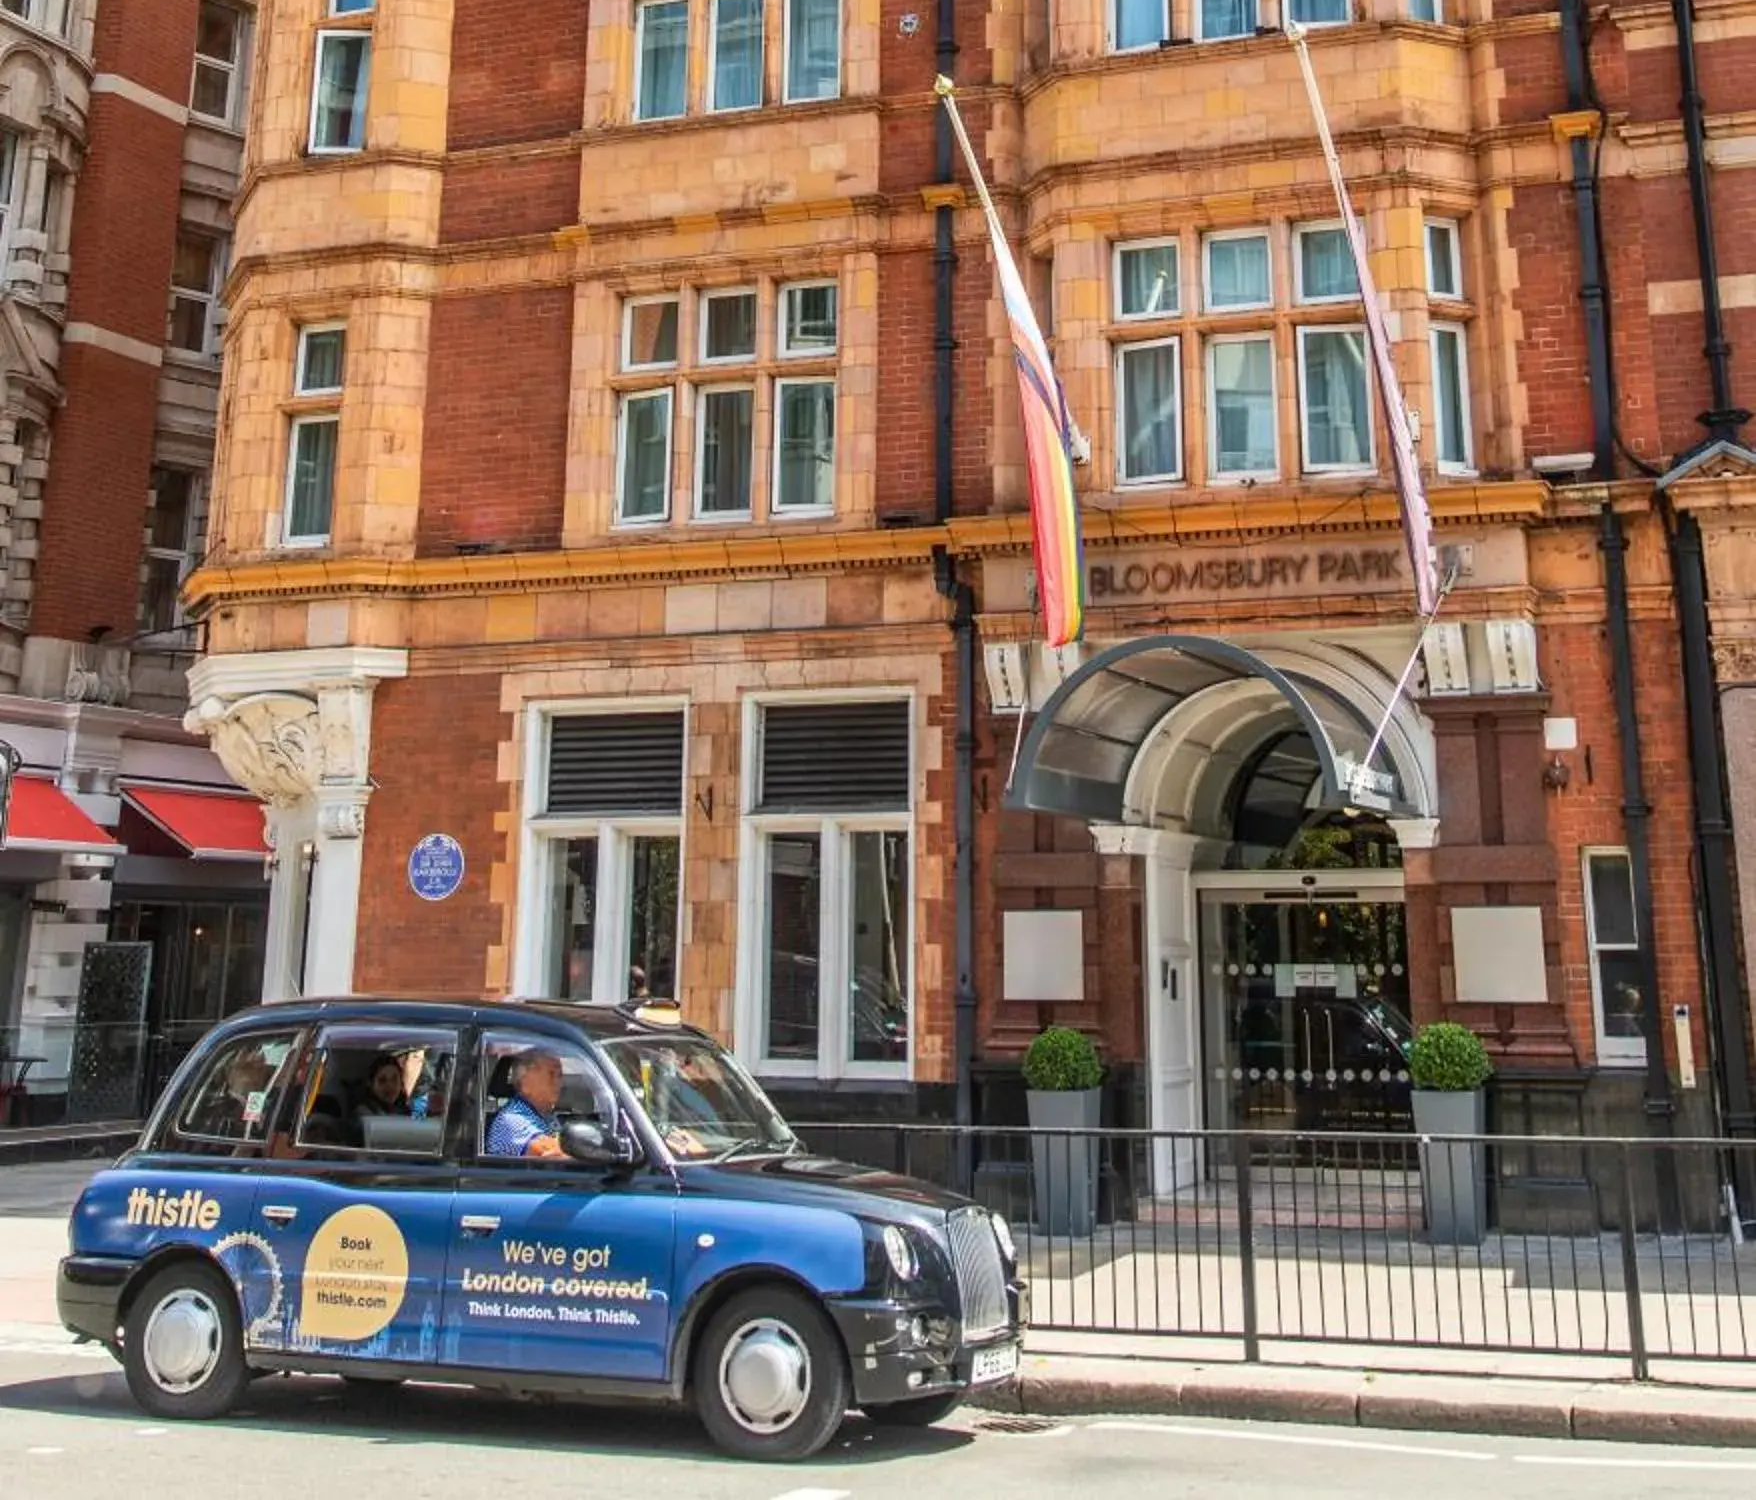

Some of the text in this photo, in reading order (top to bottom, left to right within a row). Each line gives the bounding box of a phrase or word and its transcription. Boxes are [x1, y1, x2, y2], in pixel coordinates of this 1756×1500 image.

[1089, 549, 1402, 596] BLOOMSBURY PARK
[127, 1187, 221, 1230] thistle
[340, 1236, 372, 1251] Book
[503, 1240, 611, 1273] We've got
[317, 1290, 387, 1309] thistle.com
[461, 1268, 652, 1300] London covered.
[468, 1301, 640, 1325] Think London. Think Thistle.
